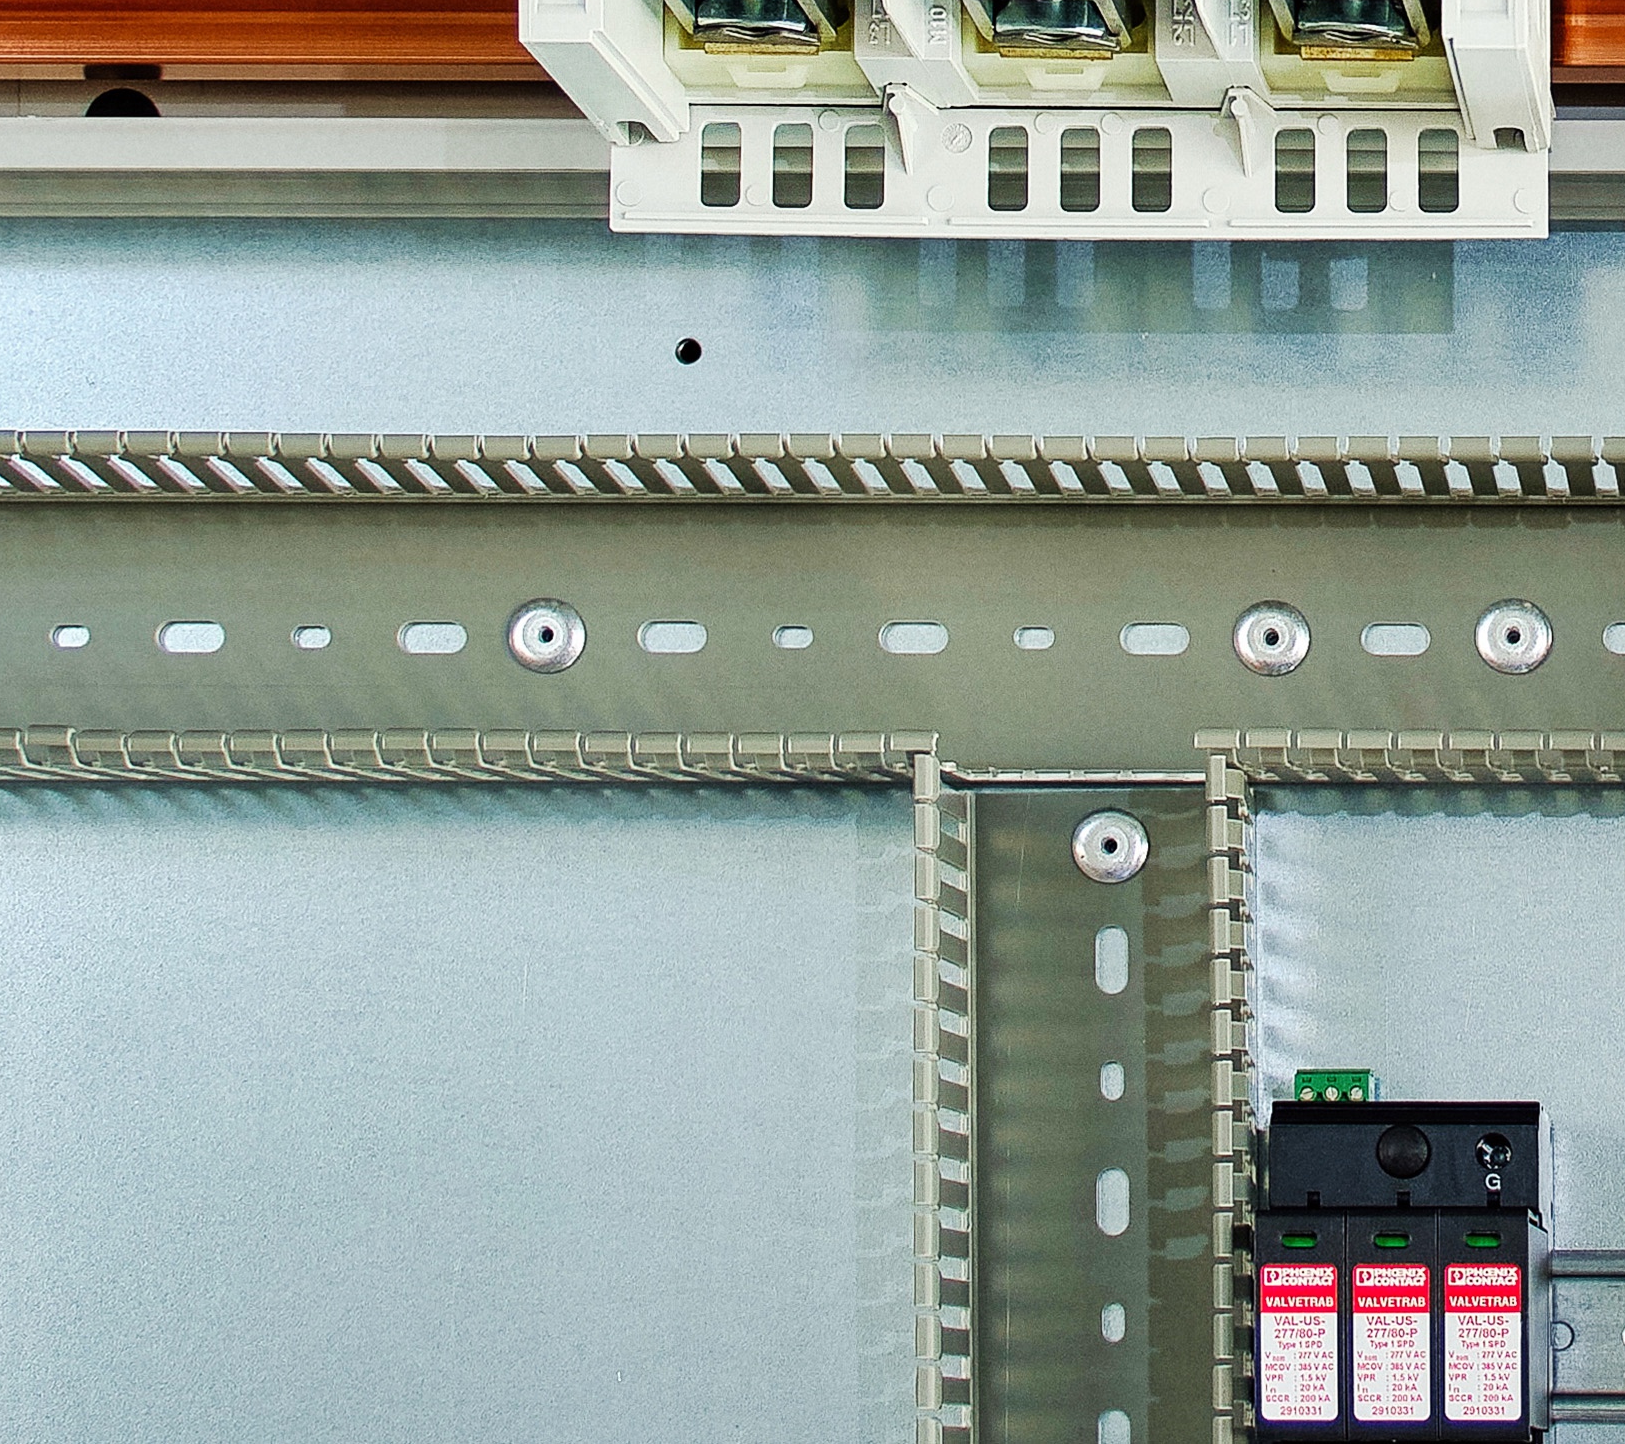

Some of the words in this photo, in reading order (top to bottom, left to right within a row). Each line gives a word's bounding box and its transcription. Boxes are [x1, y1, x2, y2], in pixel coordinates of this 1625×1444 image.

[1485, 1174, 1502, 1192] G
[1282, 1277, 1334, 1286] CONTACT
[1374, 1277, 1425, 1286] CONTACT
[1465, 1277, 1517, 1286] CONTACT
[1266, 1297, 1333, 1307] VALVETRAB
[1358, 1297, 1426, 1307] VALVETRAB
[1449, 1296, 1517, 1307] VALVETRAB
[1275, 1316, 1325, 1326] VAL-US-
[1367, 1316, 1418, 1326] VAL-US-
[1458, 1316, 1509, 1326] VAL-US-
[1275, 1329, 1325, 1338] 277/80-P
[1367, 1329, 1418, 1338] 277/80-P
[1458, 1329, 1509, 1338] 277/80-P
[1278, 1341, 1296, 1350] Type
[1370, 1341, 1388, 1349] Type
[1462, 1341, 1479, 1350] Type
[1280, 1406, 1322, 1415] 2910331
[1372, 1406, 1414, 1415] 2910331
[1463, 1406, 1505, 1415] 2910331
